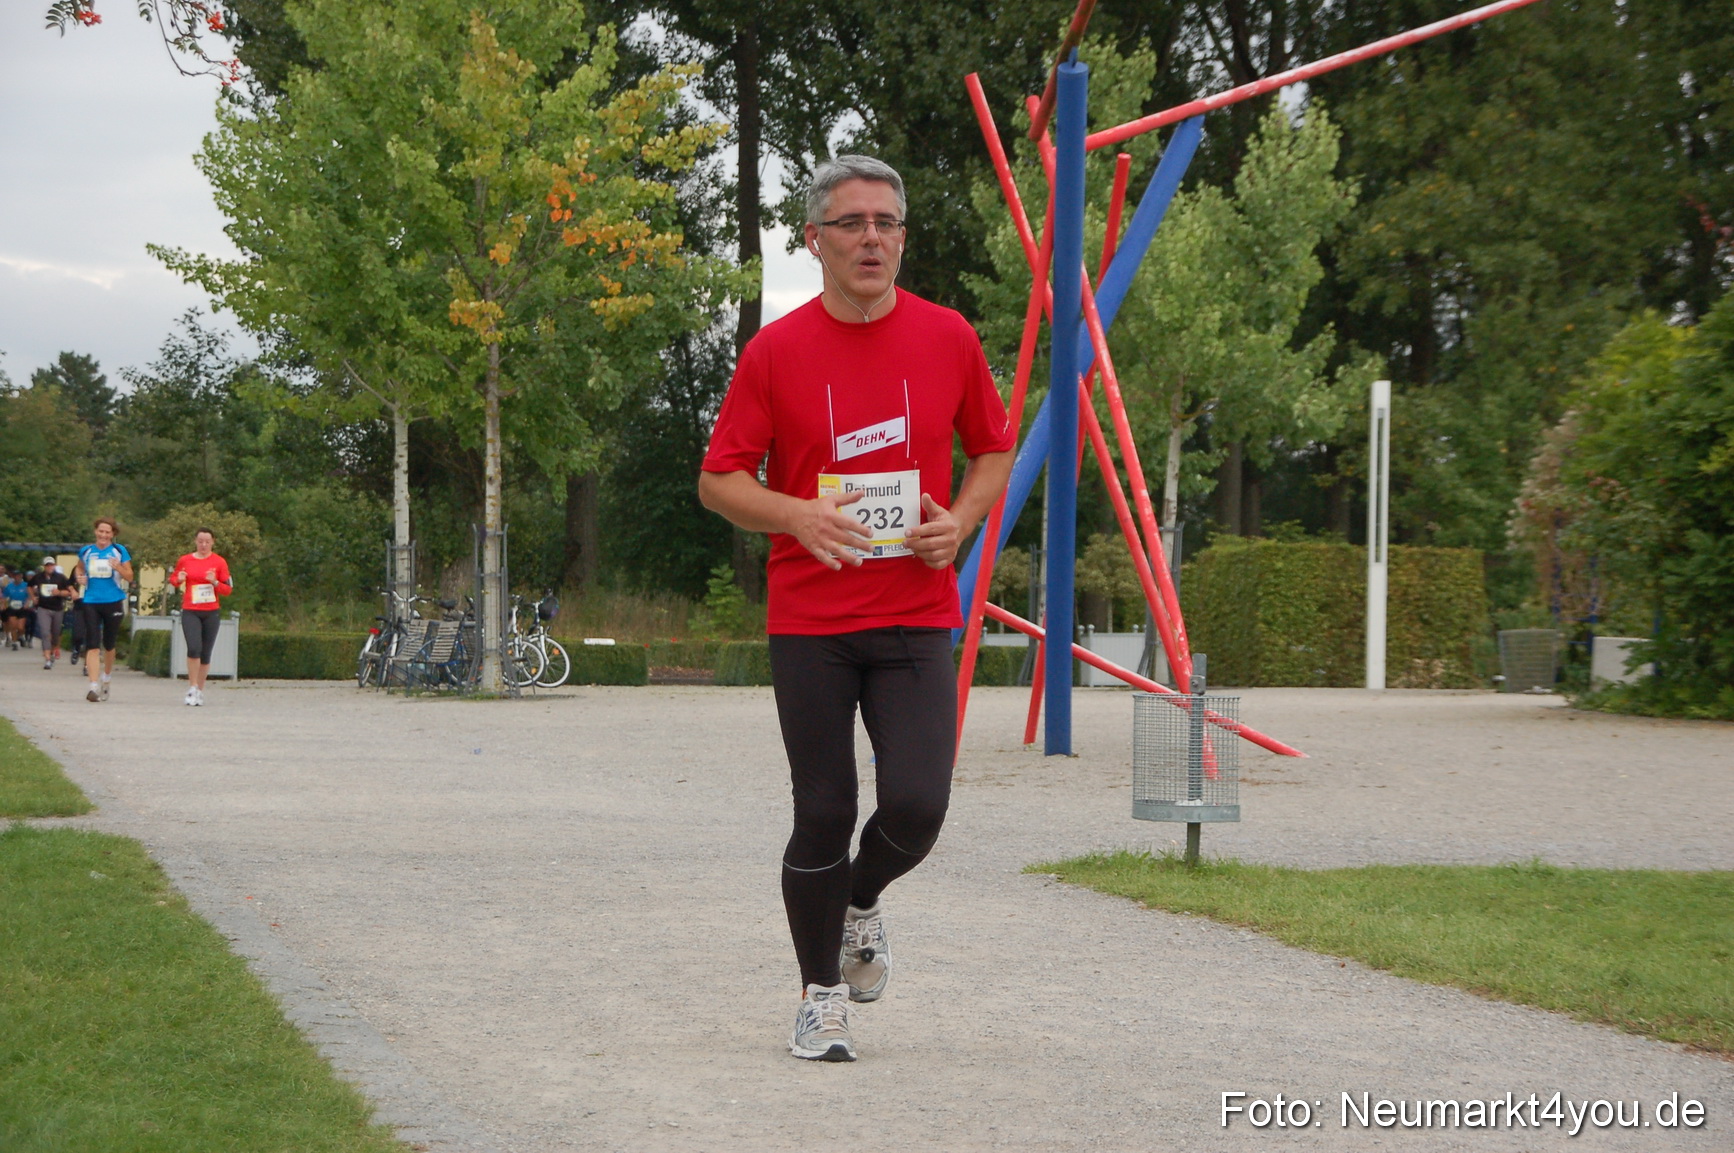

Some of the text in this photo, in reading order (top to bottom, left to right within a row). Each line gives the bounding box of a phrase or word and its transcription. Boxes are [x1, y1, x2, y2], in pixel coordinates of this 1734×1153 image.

[856, 430, 886, 448] DEHN
[856, 506, 904, 530] 232
[884, 543, 907, 552] PFLEID
